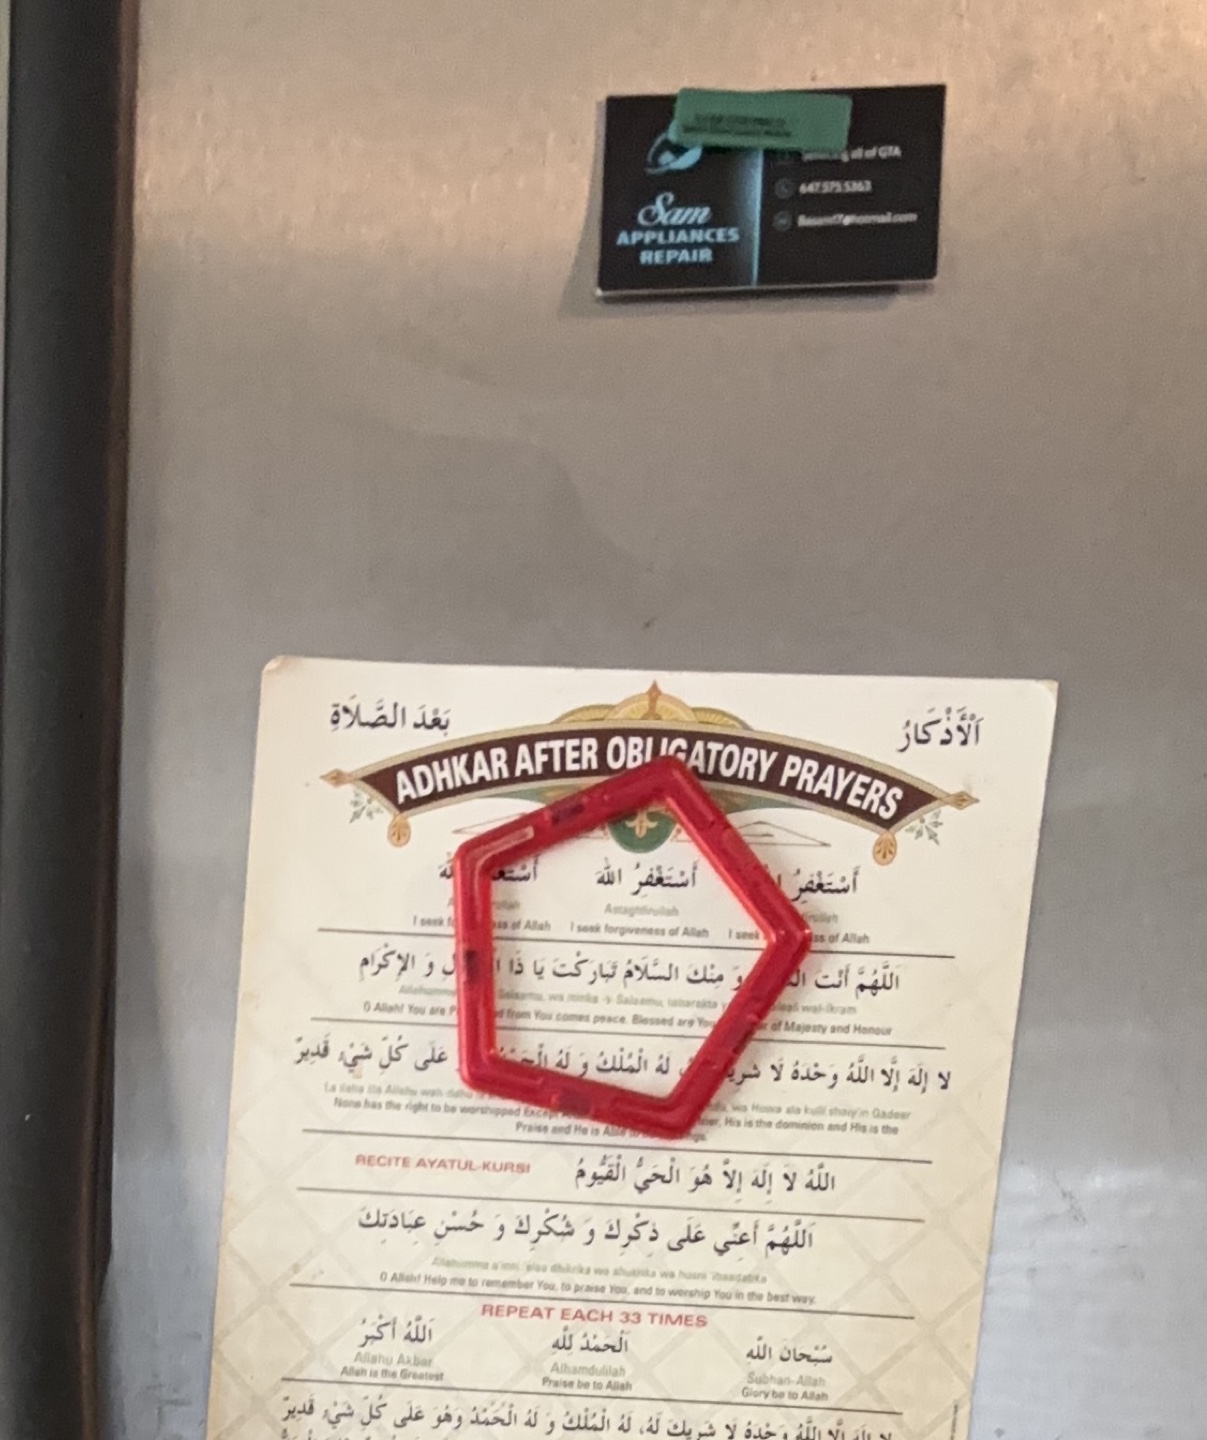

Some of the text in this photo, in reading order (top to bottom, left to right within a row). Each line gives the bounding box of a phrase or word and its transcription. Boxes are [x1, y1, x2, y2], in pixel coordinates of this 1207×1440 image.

[637, 192, 712, 226] Sam
[616, 227, 740, 246] APPLIANCES
[640, 248, 713, 265] REPAIR
[396, 736, 903, 821] ADHKAR AFTER OBLIGATORY PRAYERS
[570, 922, 709, 938] I seek forgiveness of Allah
[362, 1002, 370, 1011] O
[407, 1004, 425, 1014] You
[506, 1009, 530, 1019] from
[534, 1010, 552, 1020] You
[554, 1014, 590, 1022] comes
[631, 1015, 673, 1026] Blessed
[770, 1022, 892, 1036] of Majesty and Honour
[354, 1154, 530, 1173] RECITE AYATUL-KURSI
[379, 1273, 387, 1282] O
[423, 1275, 447, 1287] Help
[467, 1278, 478, 1286] to
[481, 1278, 534, 1289] remember
[560, 1283, 571, 1291] to
[573, 1282, 606, 1295] praise
[632, 1285, 652, 1295] and
[654, 1287, 666, 1296] to
[667, 1287, 710, 1300] worship
[713, 1289, 732, 1299] You
[734, 1290, 744, 1299] in
[746, 1291, 763, 1300] the
[766, 1292, 790, 1302] best
[480, 1304, 708, 1326] REPEAT EACH 33 TIMES
[396, 1353, 432, 1365] Akbar
[340, 1366, 444, 1380] Allah is the Greatest
[541, 1377, 632, 1391] Praise be to Allah
[741, 1387, 828, 1400] Glory be to Allah
